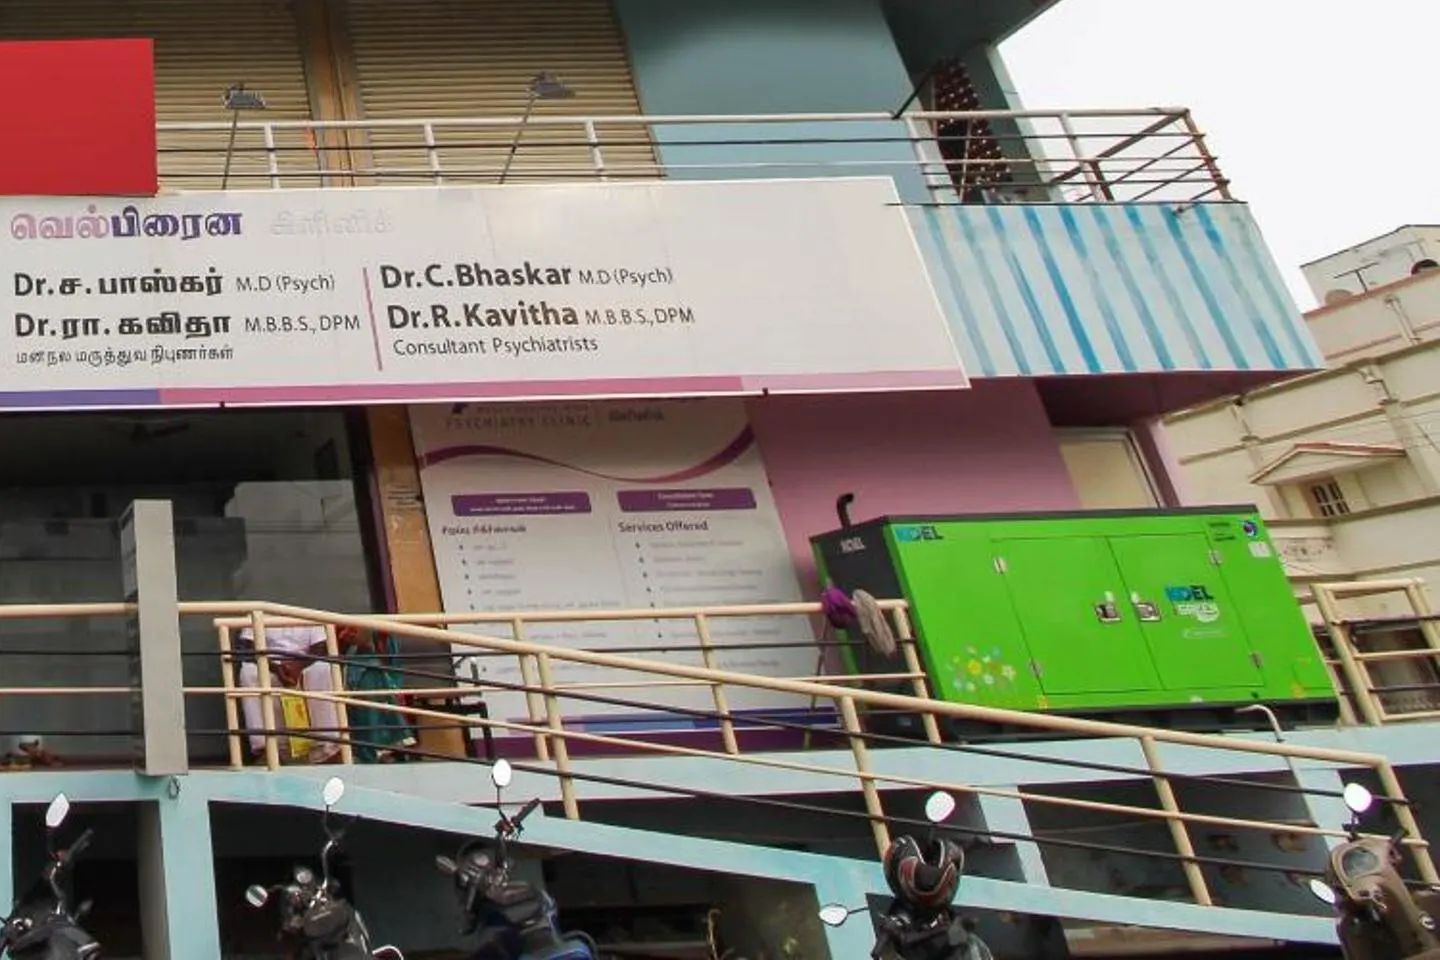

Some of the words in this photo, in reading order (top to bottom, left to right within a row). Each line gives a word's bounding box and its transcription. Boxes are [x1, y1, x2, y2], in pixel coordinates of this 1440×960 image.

[393, 338, 486, 357] Consultant
[492, 336, 599, 358] Psychiatrists
[618, 521, 664, 534] Services
